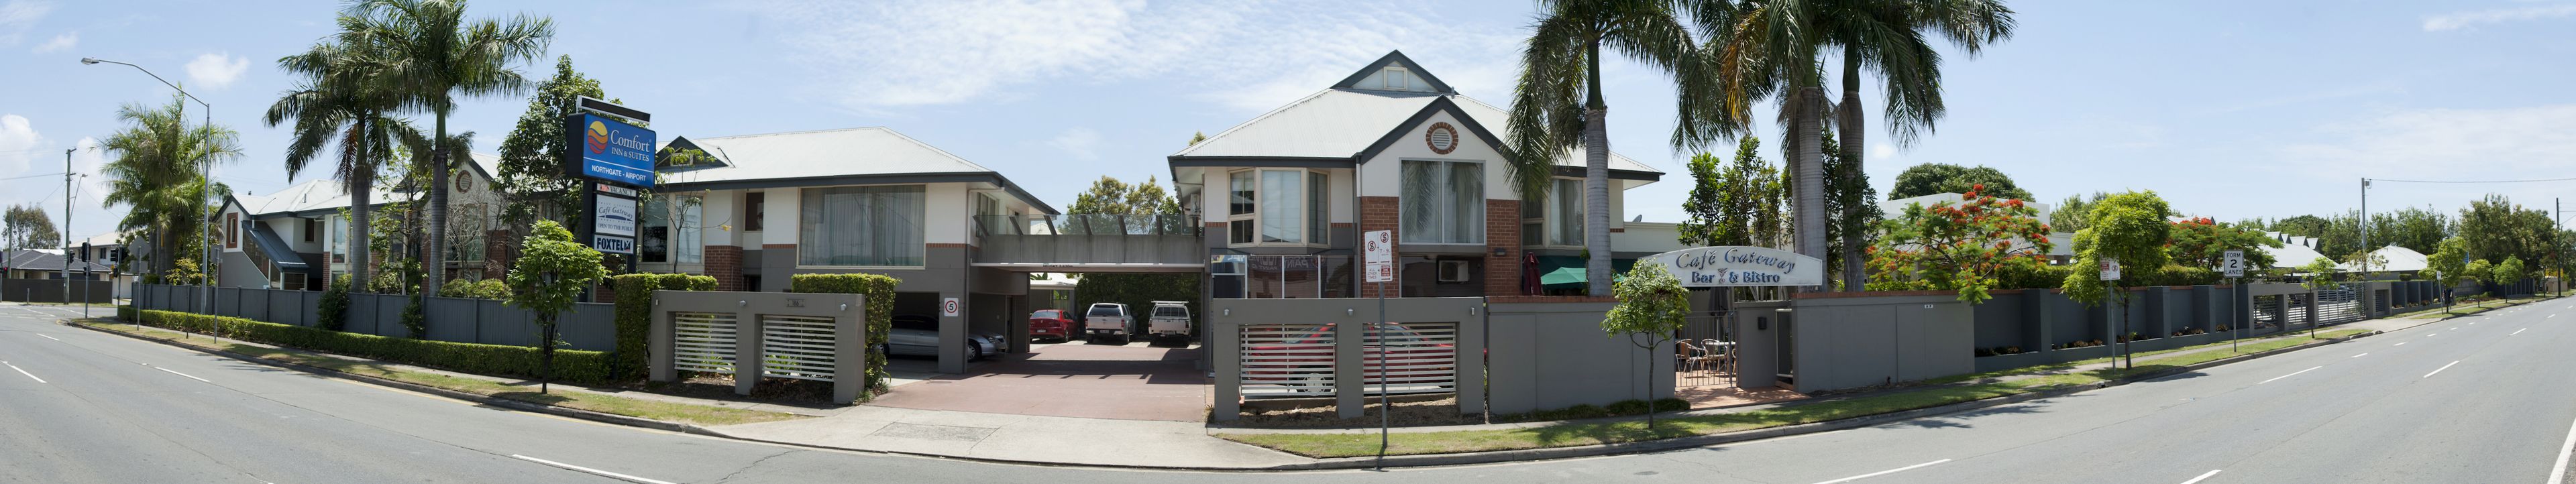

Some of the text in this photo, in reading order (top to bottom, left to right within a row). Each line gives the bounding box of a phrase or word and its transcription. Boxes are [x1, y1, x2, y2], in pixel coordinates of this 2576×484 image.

[610, 129, 650, 152] Comfort
[611, 147, 623, 156] INN
[628, 152, 649, 162] SUITES
[592, 165, 622, 177] NORTHGATE
[625, 172, 647, 182] AIRPORT
[610, 186, 633, 196] VACANCY
[598, 206, 633, 219] Café Gateway
[596, 237, 624, 251] FOXTEL
[1676, 247, 1796, 274] Café Gateway
[2230, 259, 2237, 268] 2
[1691, 271, 1780, 283] Bar & Bistro
